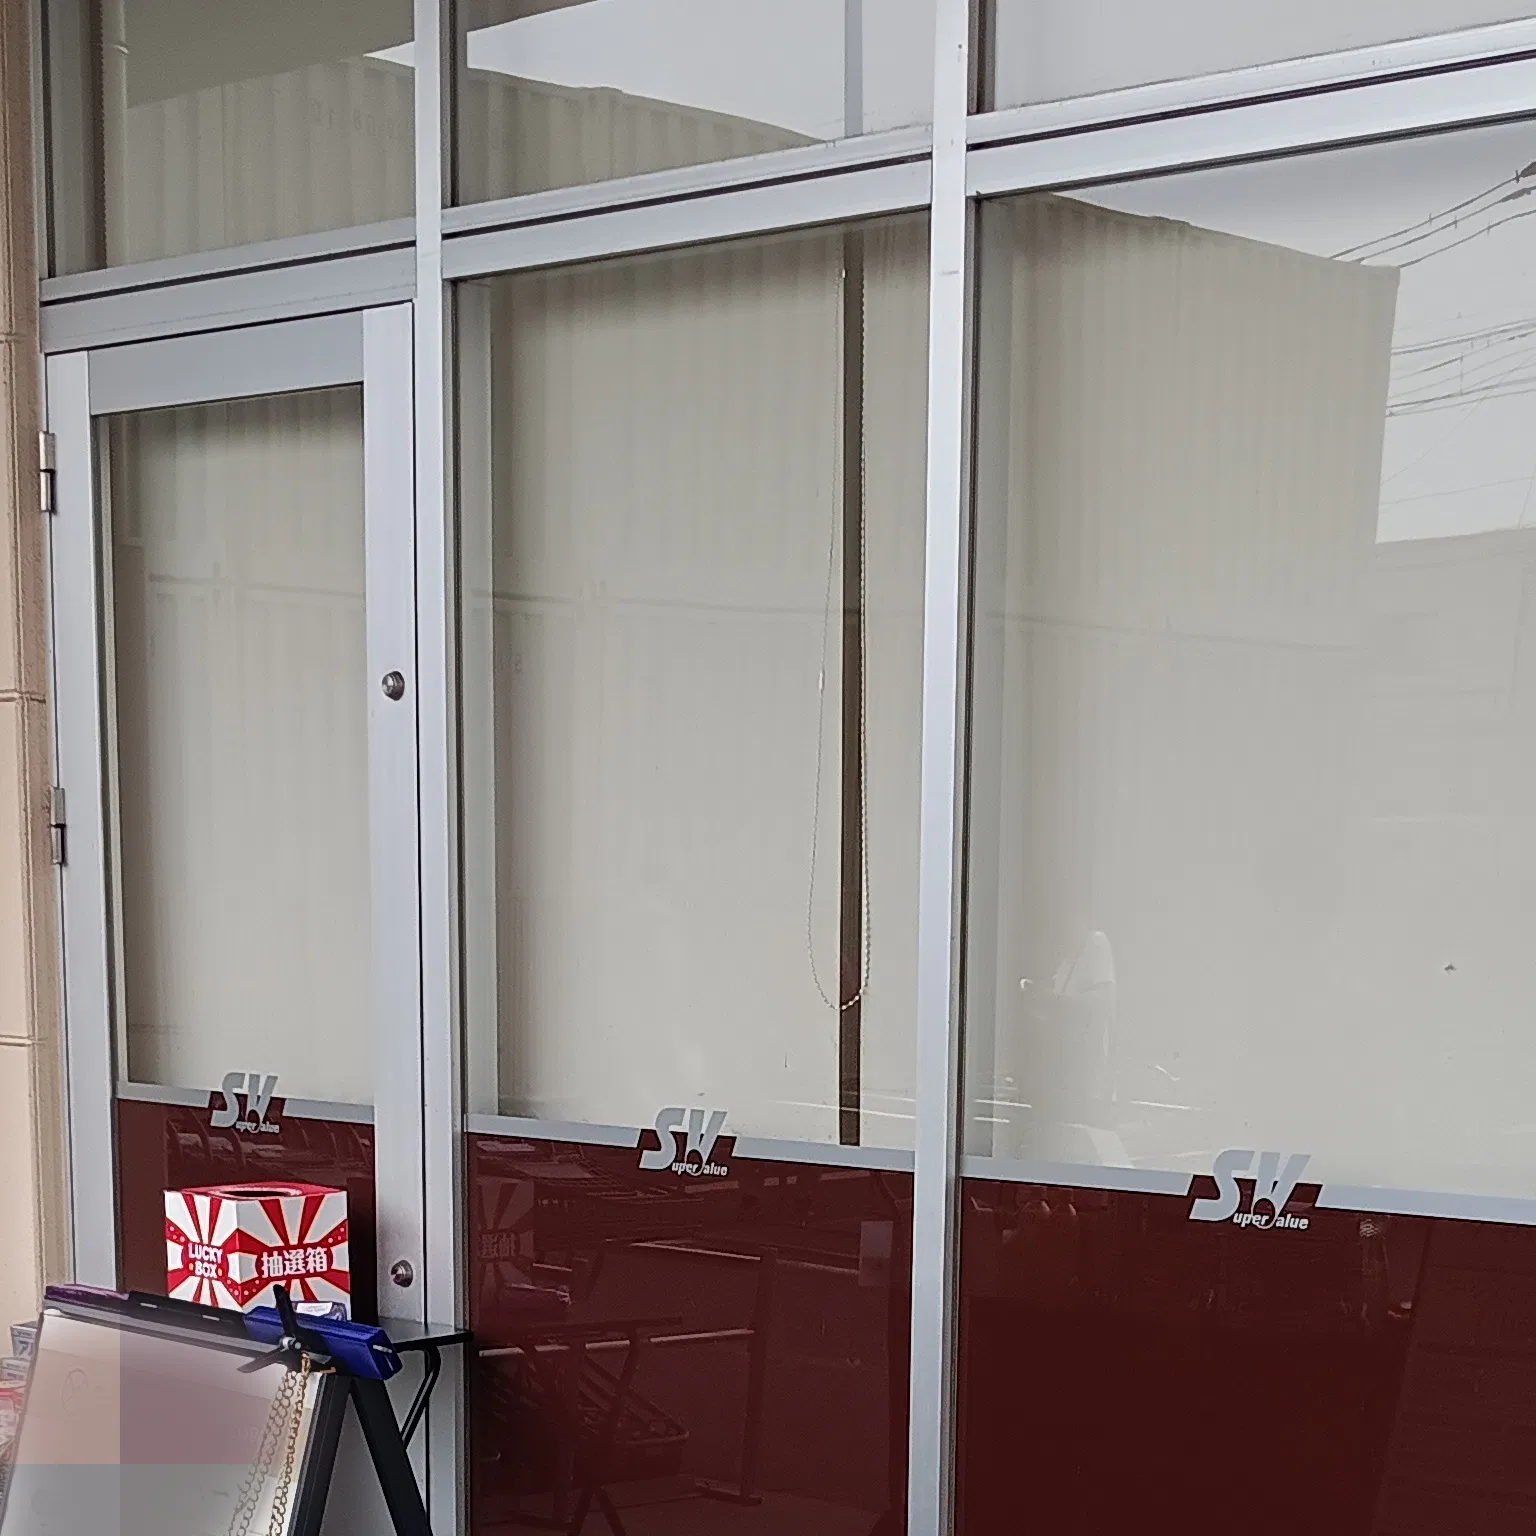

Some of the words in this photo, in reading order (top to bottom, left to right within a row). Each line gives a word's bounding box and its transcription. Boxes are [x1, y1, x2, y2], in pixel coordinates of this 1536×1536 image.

[188, 1242, 223, 1264] LUCKY
[261, 1246, 328, 1278] 抽選箱
[195, 1262, 218, 1278] BOX
